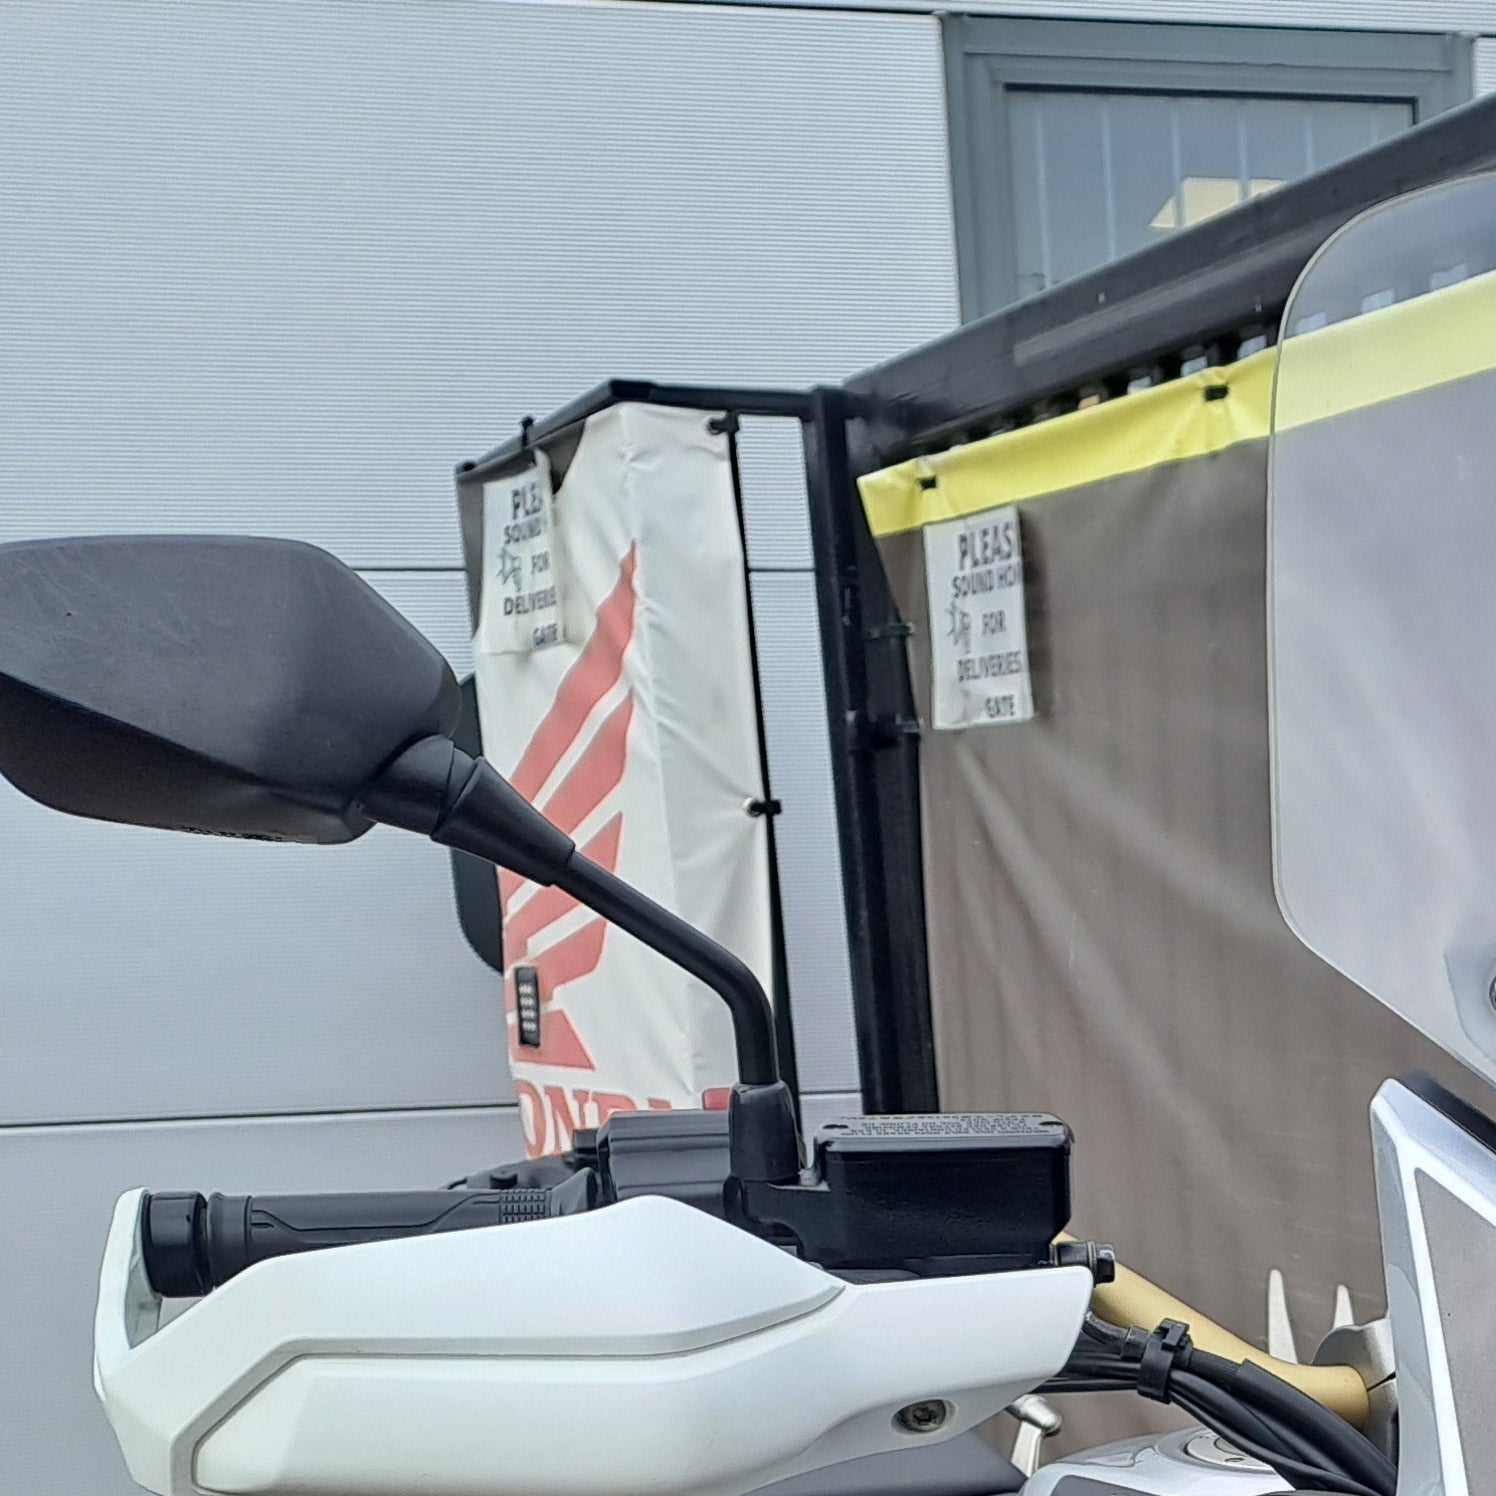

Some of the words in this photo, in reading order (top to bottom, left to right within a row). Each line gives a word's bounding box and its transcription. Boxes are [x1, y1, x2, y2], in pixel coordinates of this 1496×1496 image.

[953, 568, 994, 598] SOUND
[981, 610, 1006, 636] FOR
[985, 694, 1015, 719] GATE
